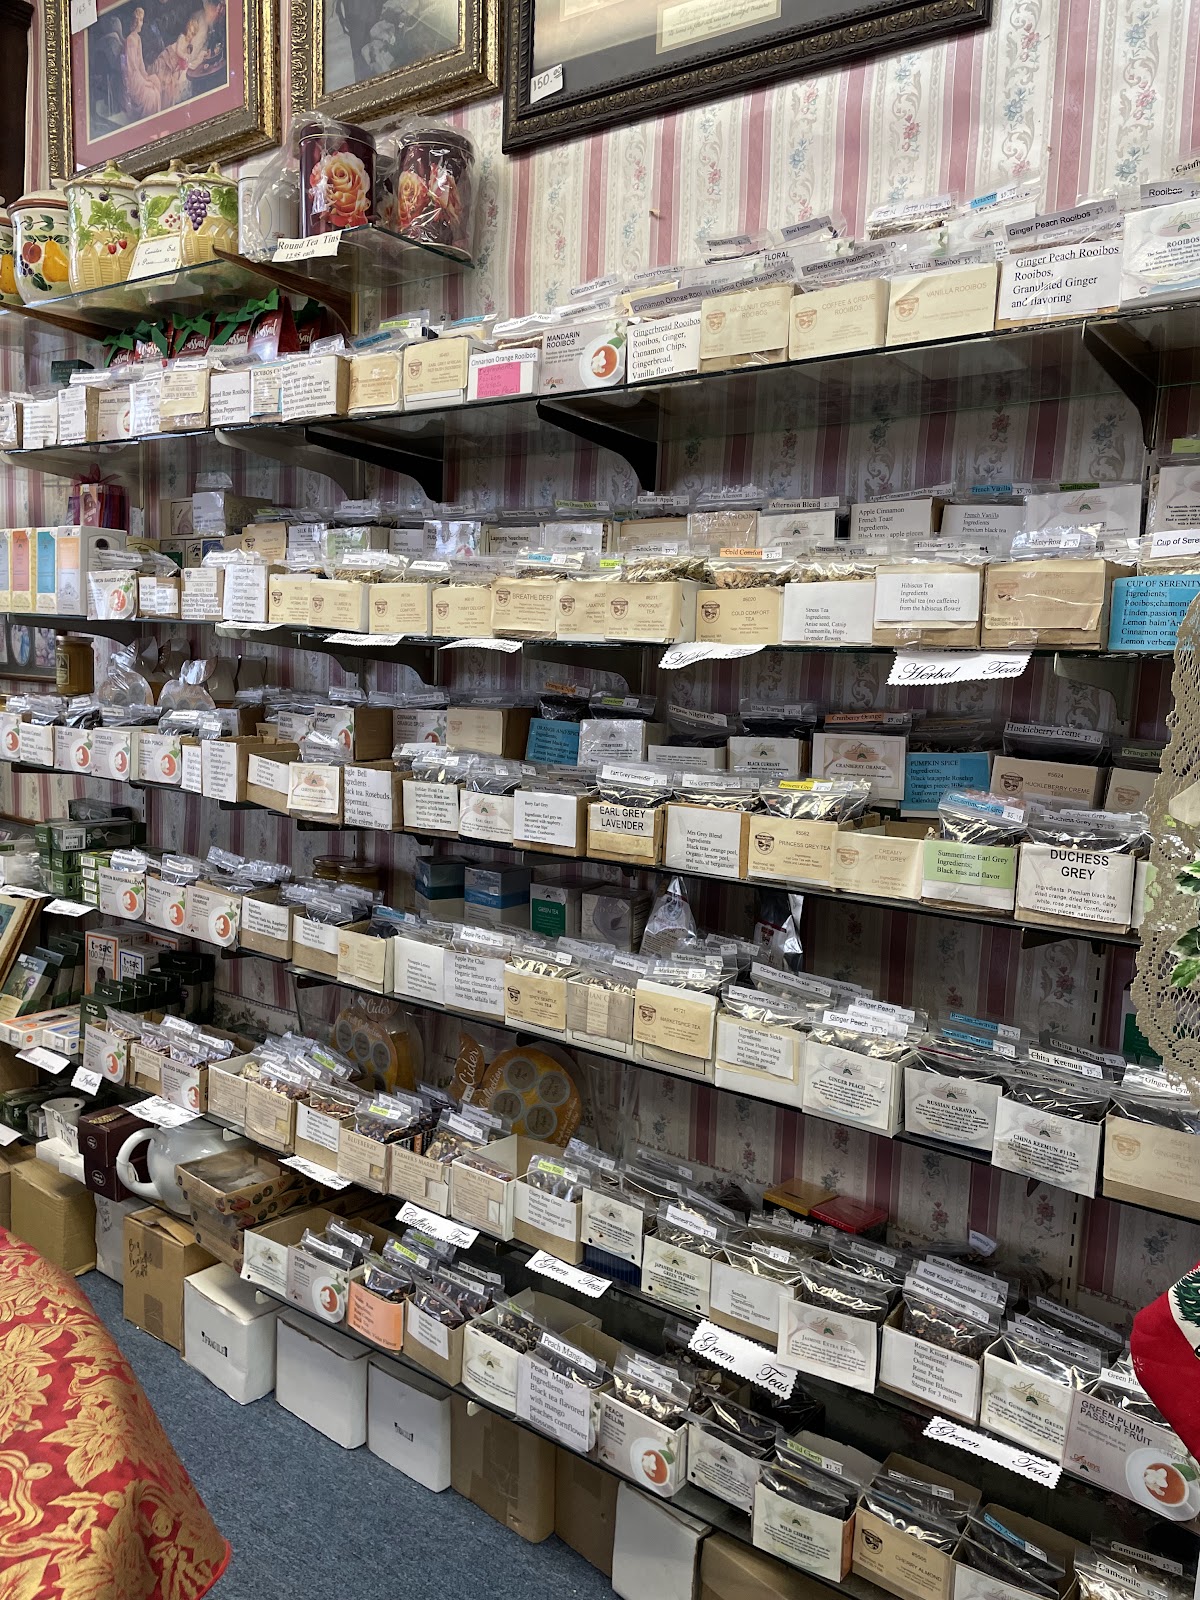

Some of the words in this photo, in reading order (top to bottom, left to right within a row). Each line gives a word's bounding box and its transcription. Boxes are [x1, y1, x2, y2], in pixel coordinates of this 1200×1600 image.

[532, 73, 553, 91] 150.
[1149, 187, 1182, 196] Rooibos
[1009, 226, 1032, 237] Ginger
[1034, 218, 1058, 230] Peach
[1059, 210, 1091, 225] Rooibos
[277, 240, 304, 251] Round
[308, 238, 318, 246] Tea
[323, 235, 339, 244] Tins
[1015, 256, 1047, 268] Ginger
[1049, 251, 1075, 262] Peach
[1079, 245, 1119, 258] Rooibos
[1014, 270, 1054, 281] Rooibos,
[1013, 281, 1063, 293] Granulated
[1065, 277, 1097, 289] Ginger
[634, 298, 664, 313] Cinnamon
[666, 293, 684, 304] Orange
[1011, 298, 1027, 308] and
[1030, 293, 1072, 307] flavoring
[547, 331, 580, 341] MANDARIN
[633, 321, 672, 338] Gingerbread
[674, 317, 700, 329] Rooibos
[547, 339, 575, 349] ROOIBOS
[633, 336, 660, 347] Rooibos,
[662, 332, 686, 342] Ginger,
[471, 356, 495, 366] Cinnamon
[496, 354, 514, 363] Orange
[515, 351, 536, 360] Rooibos
[632, 347, 663, 359] Cinnamon
[666, 342, 687, 353] Chips,
[632, 355, 672, 370] Gingerbread,
[632, 369, 655, 379] Vanilla
[656, 365, 674, 374] flavor
[898, 661, 957, 681] Herbal
[983, 660, 1022, 675] Teas
[1124, 748, 1148, 757] Orange
[1025, 781, 1067, 792] HUCKLEBERRY
[600, 806, 620, 816] EARL
[622, 808, 645, 818] GREY
[601, 818, 644, 830] LAVENDER
[938, 850, 976, 859] Summertime
[992, 855, 1009, 865] Grey
[1050, 849, 1109, 866] DUCHESS
[937, 866, 953, 875] Black
[981, 872, 1000, 880] flavor
[1061, 867, 1095, 880] GREY
[538, 906, 550, 914] GREEN
[454, 963, 477, 971] Ingredients
[470, 981, 491, 989] cinnamon
[857, 1000, 878, 1009] Ginger
[878, 1005, 895, 1013] Peach
[660, 1016, 688, 1028] MARKETSPICE
[830, 1014, 848, 1024] Ginger
[850, 1018, 868, 1027] Peach
[738, 1025, 753, 1034] Orange
[163, 1063, 175, 1071] BLOOD
[175, 1068, 190, 1077] ORANGE
[458, 1048, 479, 1086] Cider
[1031, 1052, 1051, 1062] China
[1053, 1057, 1083, 1071] Keemun
[829, 1076, 847, 1084] GINGER
[848, 1082, 865, 1090] PEACH
[927, 1100, 949, 1109] RUSSIAN
[951, 1106, 977, 1115] CARAVAN
[347, 1135, 378, 1151] BLUEBERRY
[1013, 1134, 1031, 1144] CHINA
[1033, 1140, 1058, 1152] KEEMUN
[402, 1207, 438, 1234] Caffeine
[451, 1229, 470, 1247] Free
[752, 1243, 770, 1255] Sencha
[534, 1254, 569, 1276] Green
[578, 1274, 605, 1292] Teas
[923, 1268, 935, 1277] Rose
[937, 1273, 953, 1284] Kissed
[954, 1280, 976, 1294] Jasmine
[731, 1289, 746, 1299] Sencha
[544, 1336, 561, 1354] Peach
[802, 1335, 820, 1345] JASMINE
[822, 1340, 838, 1350] EXTRA
[840, 1346, 856, 1354] FANCY
[694, 1332, 735, 1364] Green
[756, 1363, 791, 1392] Teas
[914, 1342, 929, 1352] Rose
[930, 1348, 949, 1360] Kissed
[950, 1358, 973, 1370] Jasmine
[912, 1365, 927, 1375] Rose
[928, 1371, 945, 1382] Petals
[913, 1357, 934, 1371] Oolong
[935, 1366, 944, 1374] tea
[530, 1371, 564, 1396] Ingredients
[531, 1361, 549, 1376] Peach
[551, 1372, 574, 1389] Mango
[911, 1380, 927, 1392] Steep
[928, 1386, 937, 1395] for
[942, 1393, 957, 1404] mins
[912, 1372, 934, 1387] Jasmine
[935, 1382, 963, 1398] Blossoms
[530, 1383, 547, 1397] Black
[548, 1391, 558, 1400] tea
[559, 1395, 585, 1417] flavored
[605, 1404, 624, 1419] PEACH
[605, 1412, 625, 1428] BELLINI
[1008, 1401, 1043, 1421] GUNPOWDER
[1045, 1419, 1064, 1430] GREEN
[1081, 1400, 1114, 1421] GREEN
[1118, 1416, 1144, 1434] PLUM
[1080, 1407, 1121, 1433] PASSION
[1124, 1427, 1152, 1446] FRUIT
[790, 1440, 803, 1452] Wild
[804, 1447, 823, 1463] Cherry
[928, 1421, 980, 1448] Green
[1012, 1455, 1050, 1479] Teas
[780, 1523, 791, 1533] WILD
[794, 1530, 813, 1542] CHERRY
[1112, 1542, 1154, 1563] Camomile
[895, 1555, 915, 1568] CHERRY
[917, 1563, 942, 1583] ALMOND
[1098, 1562, 1141, 1587] Camomile
